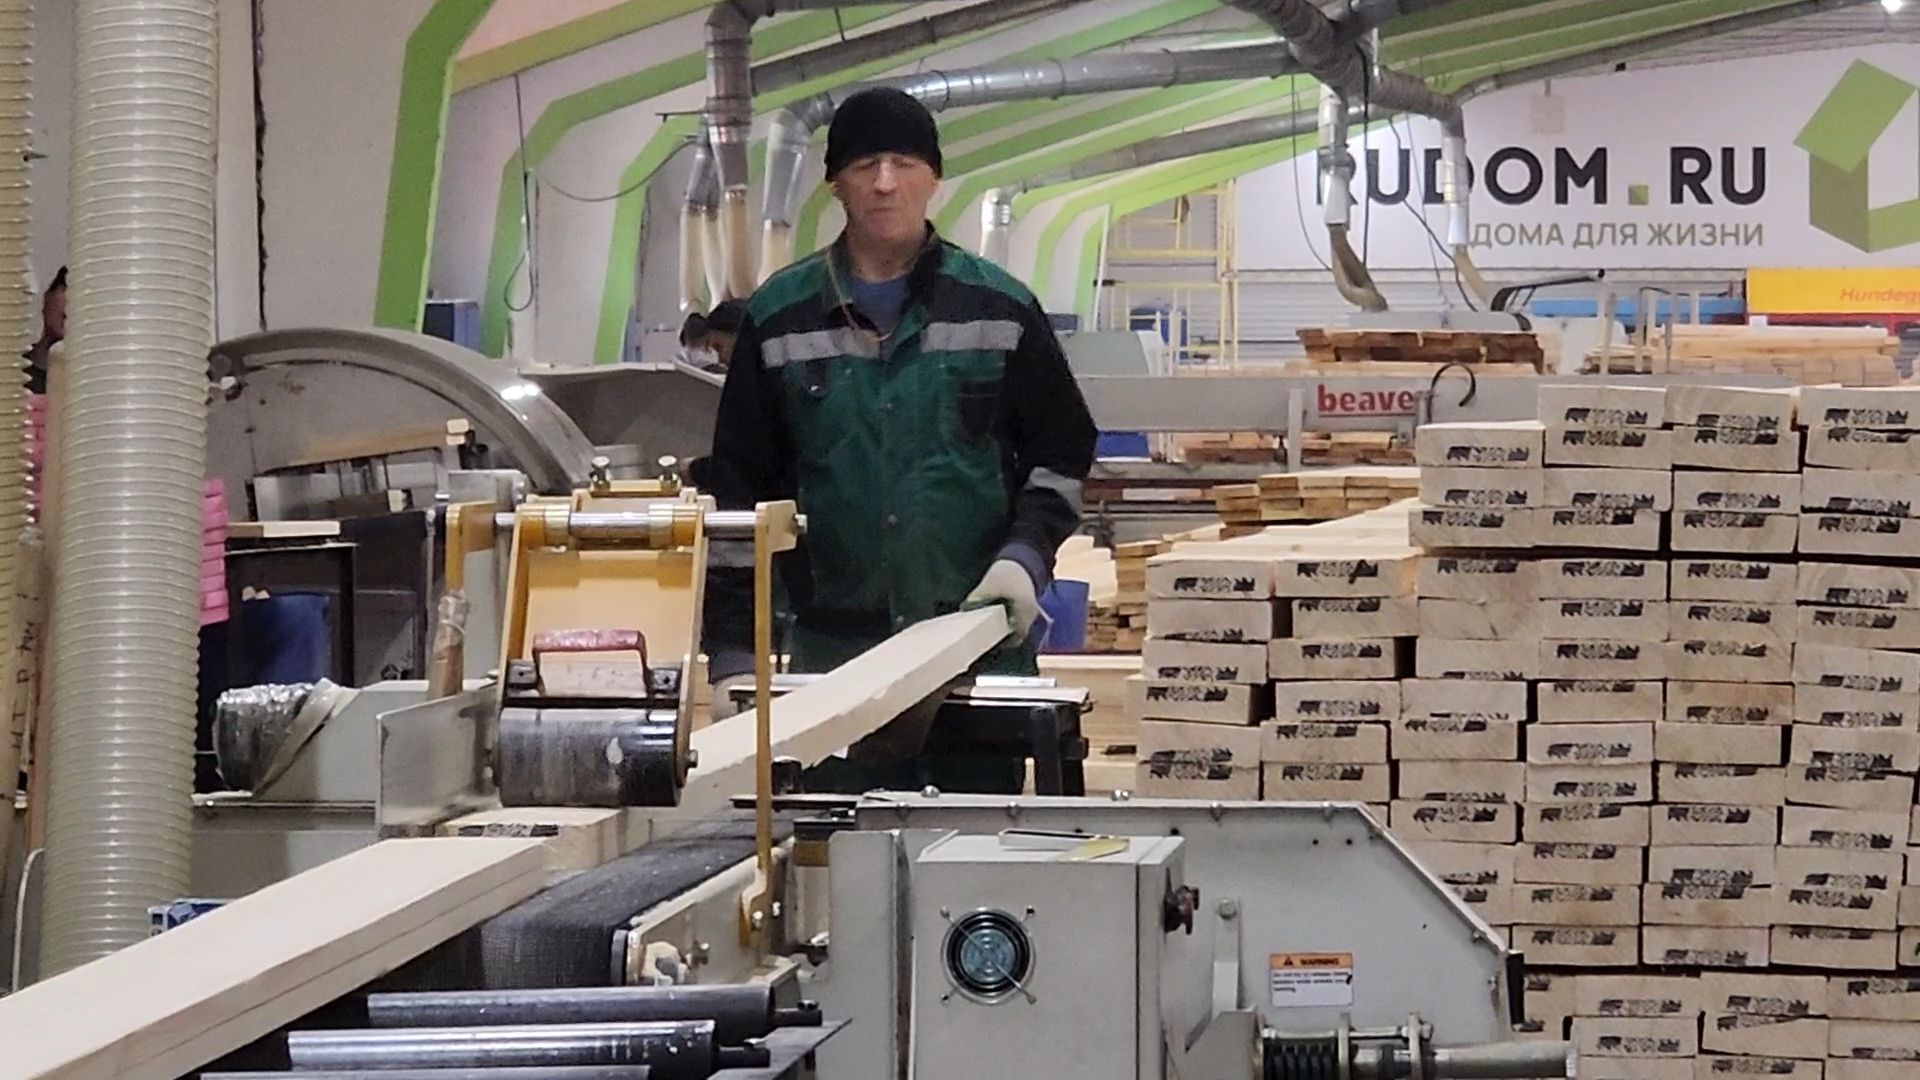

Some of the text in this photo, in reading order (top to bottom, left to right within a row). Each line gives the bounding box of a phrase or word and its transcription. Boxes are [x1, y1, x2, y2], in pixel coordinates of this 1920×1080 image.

[1470, 222, 1763, 249] ДОМА ДЛЯ ЖИЗНИ
[1839, 287, 1920, 306] Hundeg
